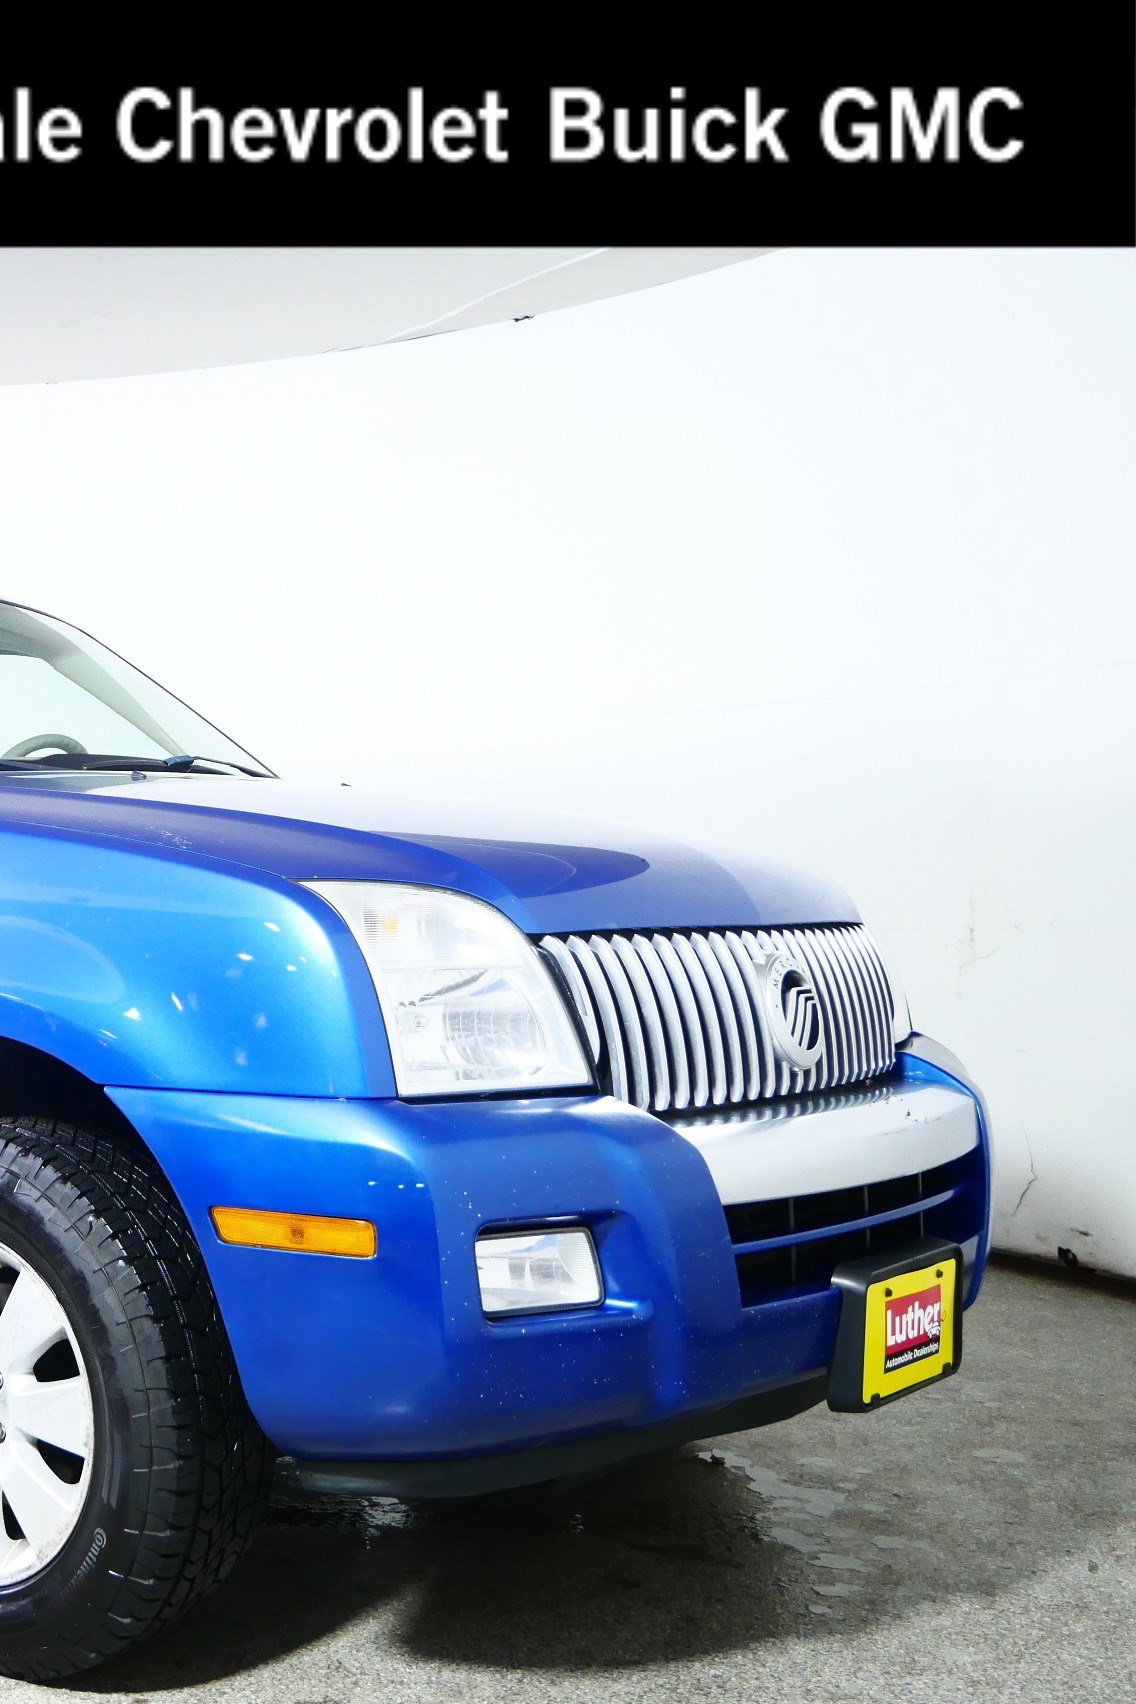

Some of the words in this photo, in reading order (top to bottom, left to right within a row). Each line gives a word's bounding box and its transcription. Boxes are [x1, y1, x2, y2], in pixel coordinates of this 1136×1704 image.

[886, 1300, 941, 1346] Luther
[885, 1351, 913, 1368] Automobile
[914, 1342, 939, 1358] Dealerships
[58, 1527, 107, 1593] Continen
